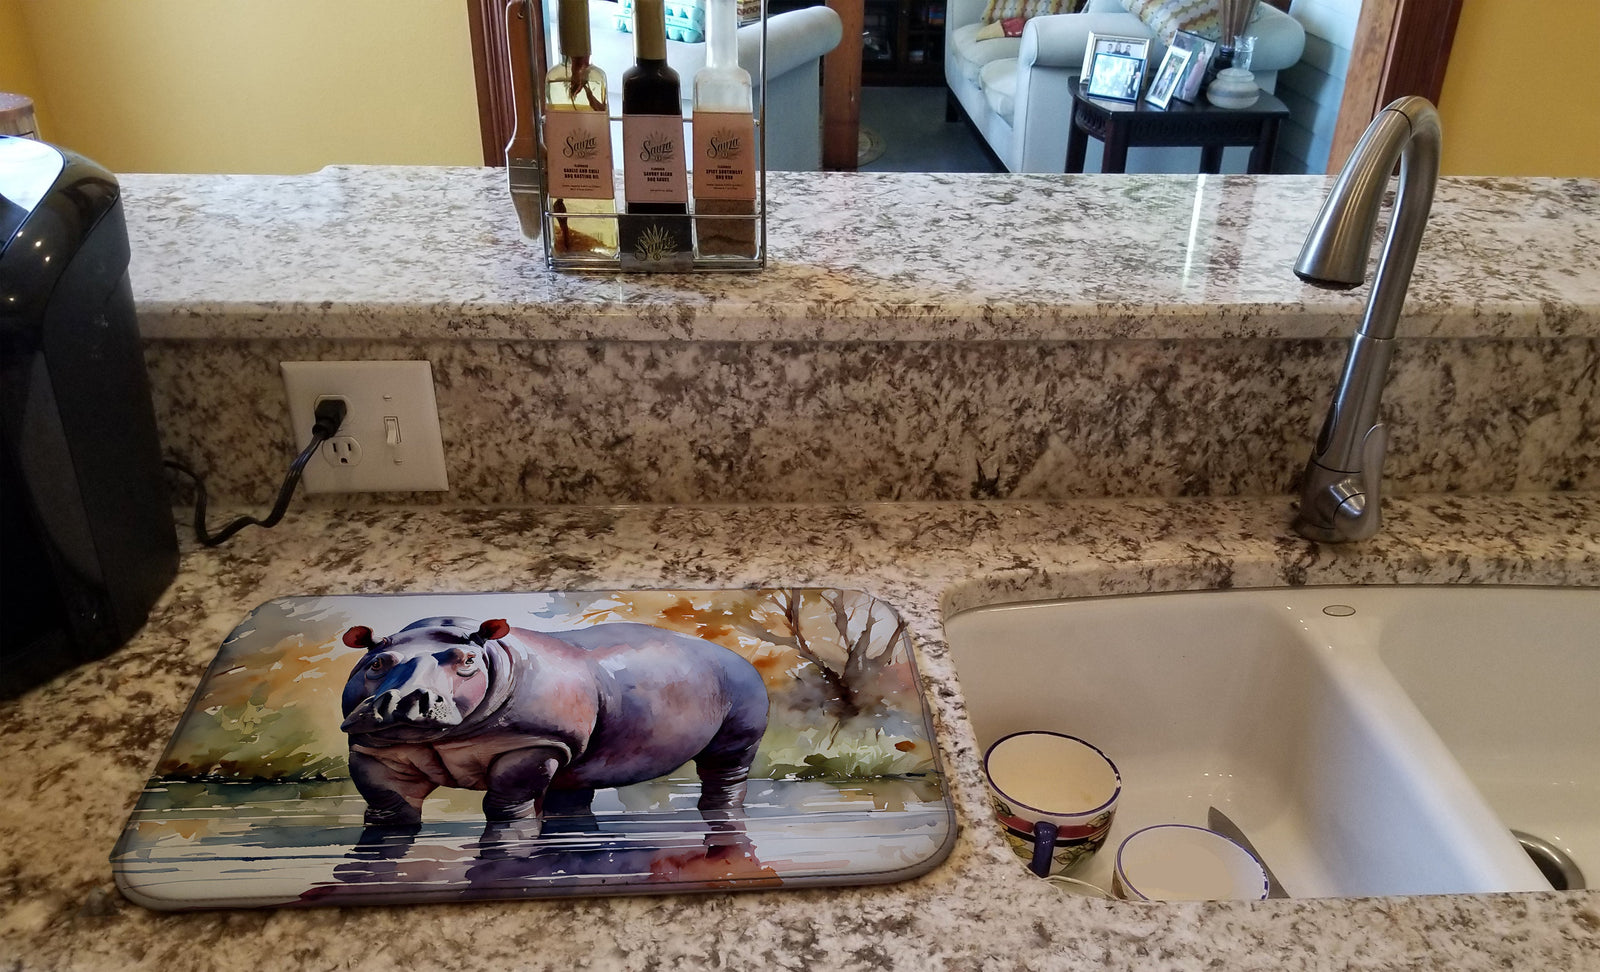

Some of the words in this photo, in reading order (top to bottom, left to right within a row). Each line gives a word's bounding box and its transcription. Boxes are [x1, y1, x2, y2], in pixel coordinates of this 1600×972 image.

[563, 136, 597, 158] Sauza
[640, 139, 673, 161] Sauza
[707, 137, 740, 159] Sauza
